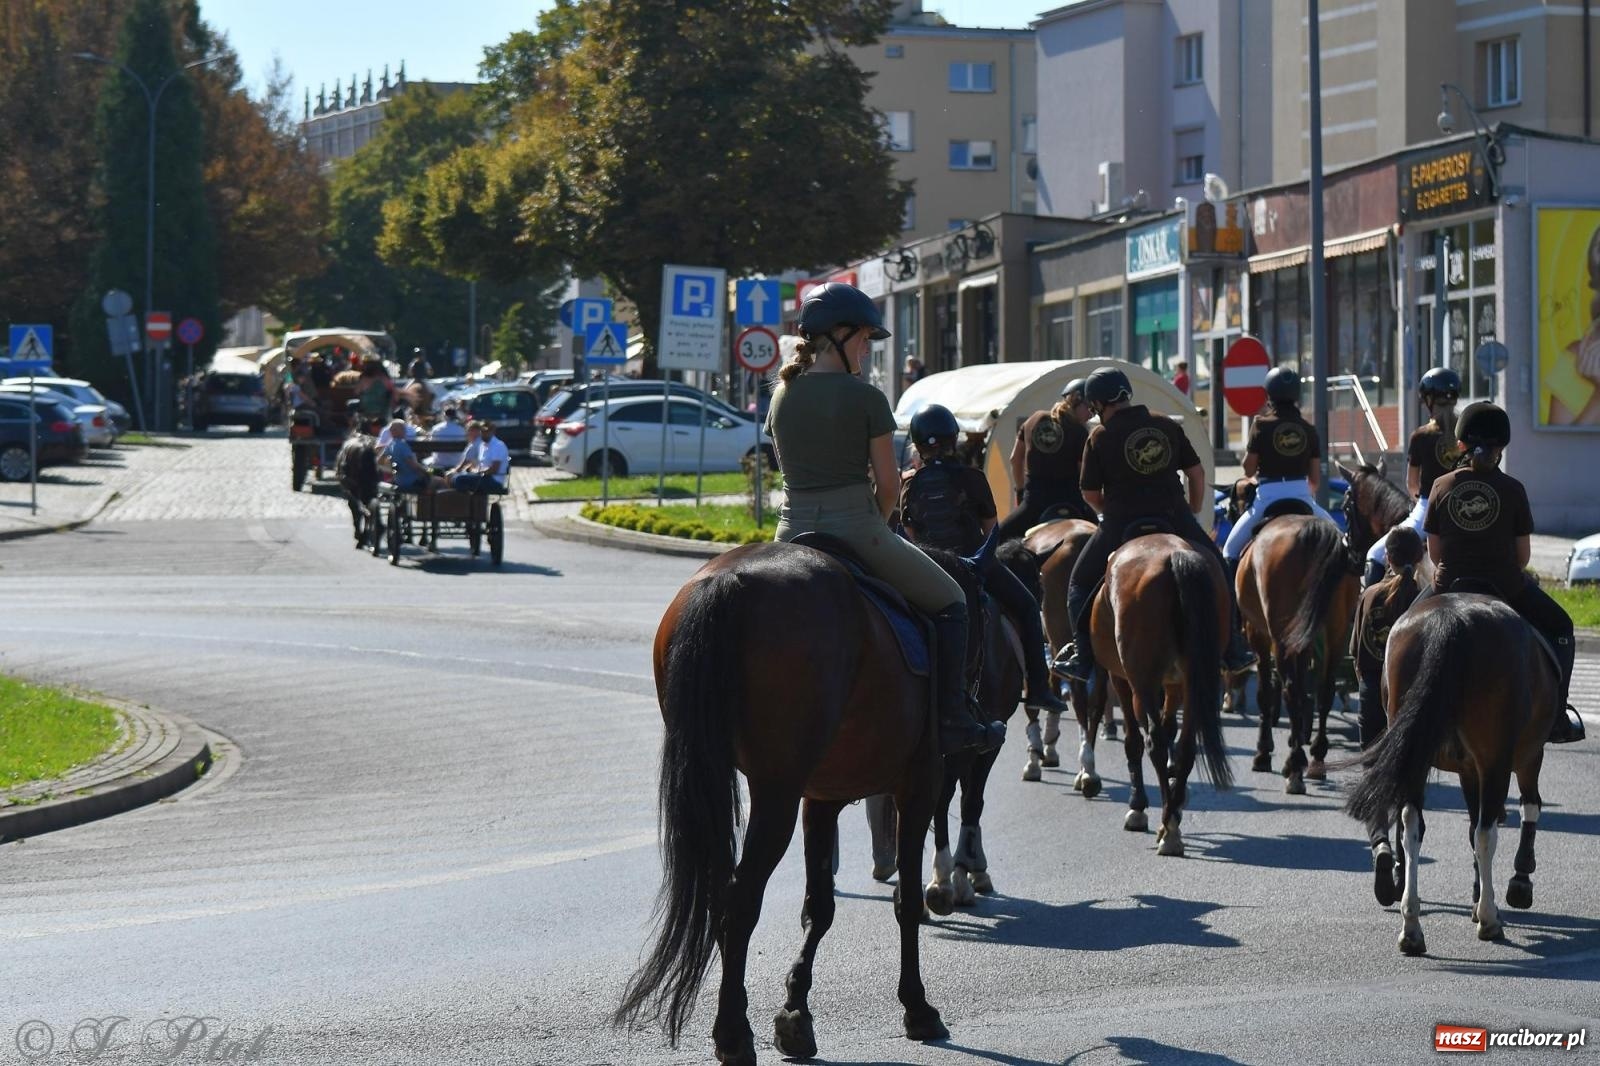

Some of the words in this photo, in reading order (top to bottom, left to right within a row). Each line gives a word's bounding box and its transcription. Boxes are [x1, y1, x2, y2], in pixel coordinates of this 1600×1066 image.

[1411, 151, 1472, 188] E-PAPIEROSY
[682, 279, 707, 312] P
[581, 302, 604, 331] P
